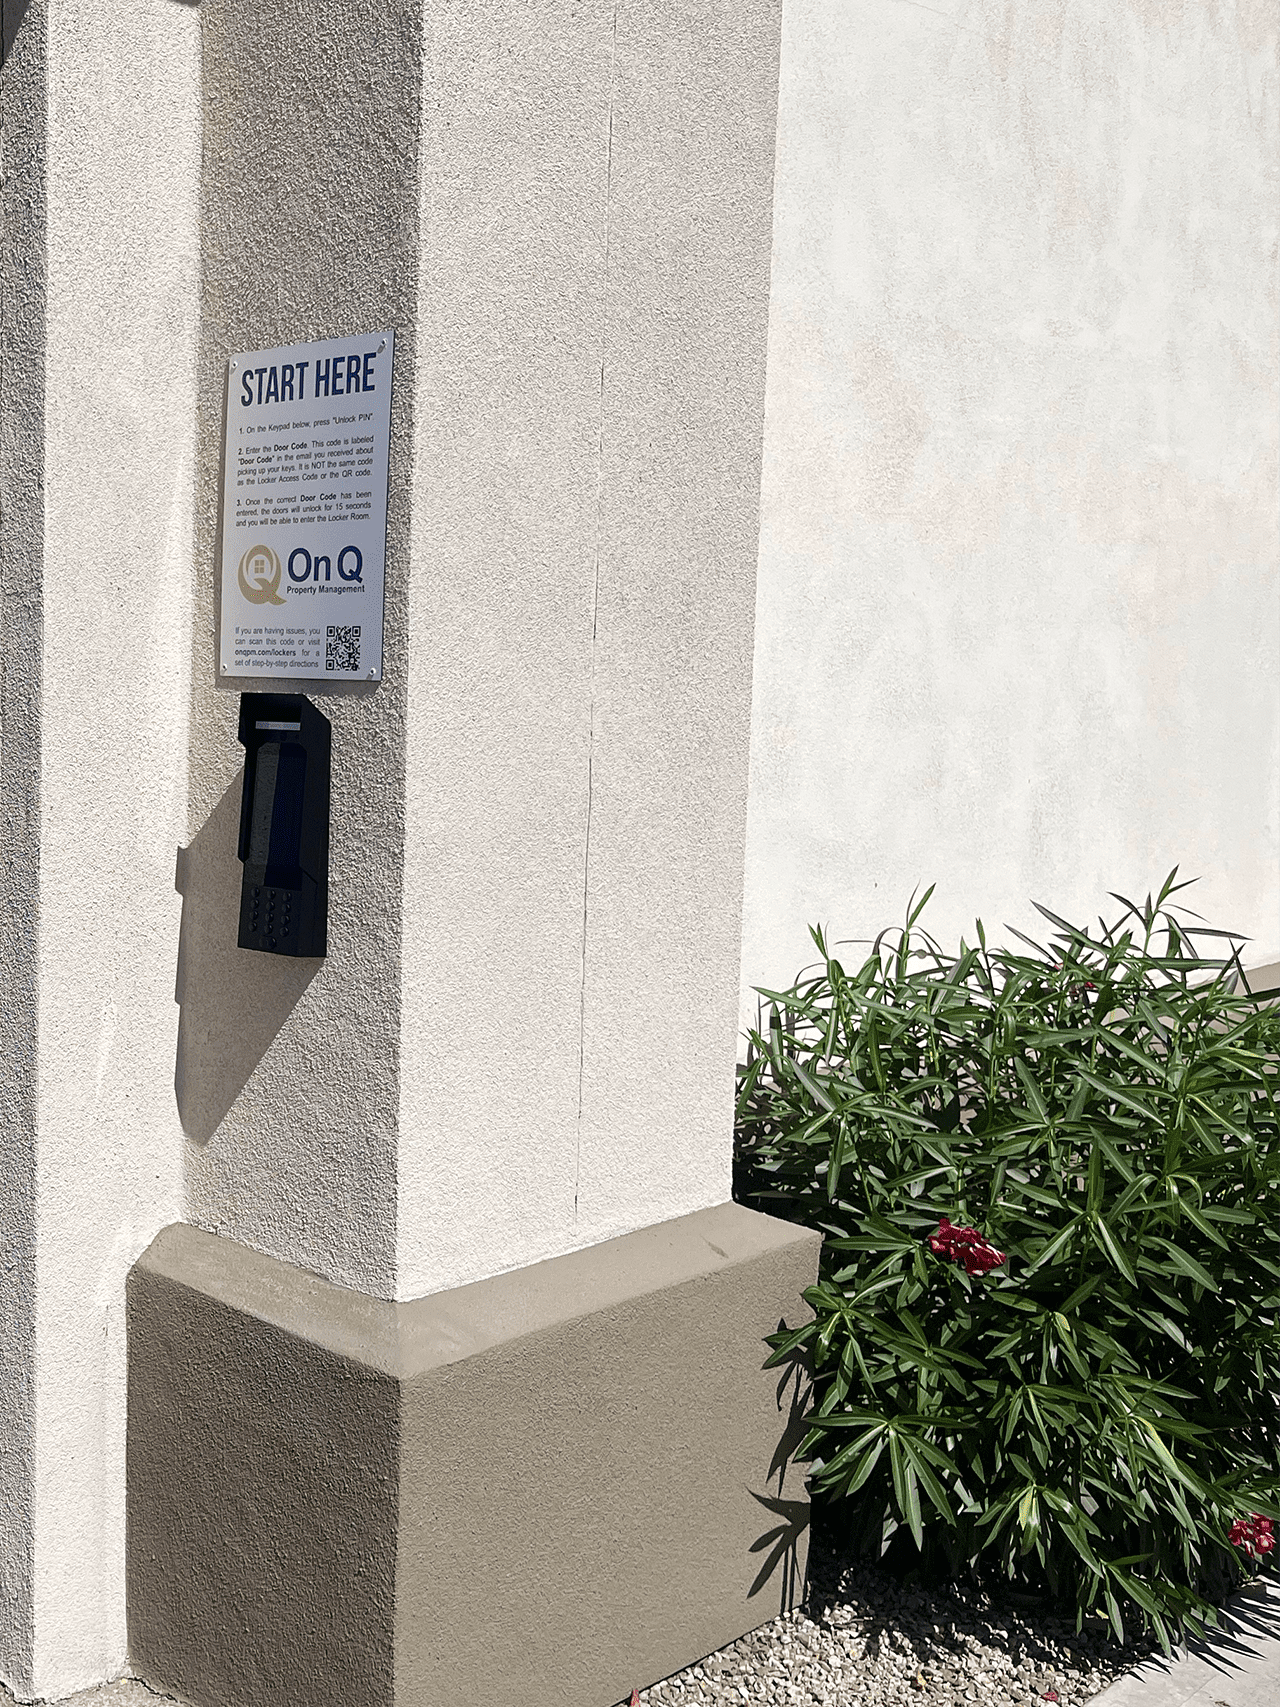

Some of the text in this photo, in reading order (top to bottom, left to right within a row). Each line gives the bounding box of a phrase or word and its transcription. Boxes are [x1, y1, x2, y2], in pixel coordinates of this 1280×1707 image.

[241, 352, 377, 407] START HERE
[246, 426, 255, 434] On
[269, 422, 290, 432] Keypad
[293, 421, 311, 429] below,
[313, 419, 330, 428] press
[333, 415, 356, 424] "Unlock
[274, 444, 289, 452] Door
[312, 440, 324, 448] This
[351, 435, 374, 444] labeled
[257, 455, 275, 464] Code"
[296, 452, 311, 460] email
[314, 452, 325, 460] you
[327, 448, 353, 457] received
[356, 447, 374, 455] about
[237, 468, 256, 477] picking
[267, 467, 280, 475] your
[312, 461, 325, 469] NOT
[302, 473, 318, 481] Code
[330, 471, 339, 479] the
[355, 469, 372, 477] code.
[246, 498, 260, 506] Once
[277, 496, 296, 504] correct
[320, 493, 336, 501] Code
[236, 509, 258, 517] entered,
[346, 501, 371, 510] seconds
[236, 519, 246, 527] and
[288, 545, 363, 583] On Q
[286, 585, 365, 595] Property Management
[241, 628, 251, 636] you
[265, 627, 284, 636] having
[286, 627, 307, 635] issues,
[308, 628, 320, 636] you
[235, 649, 296, 657] onqpm.com/lockers
[252, 660, 288, 668] step-by-step
